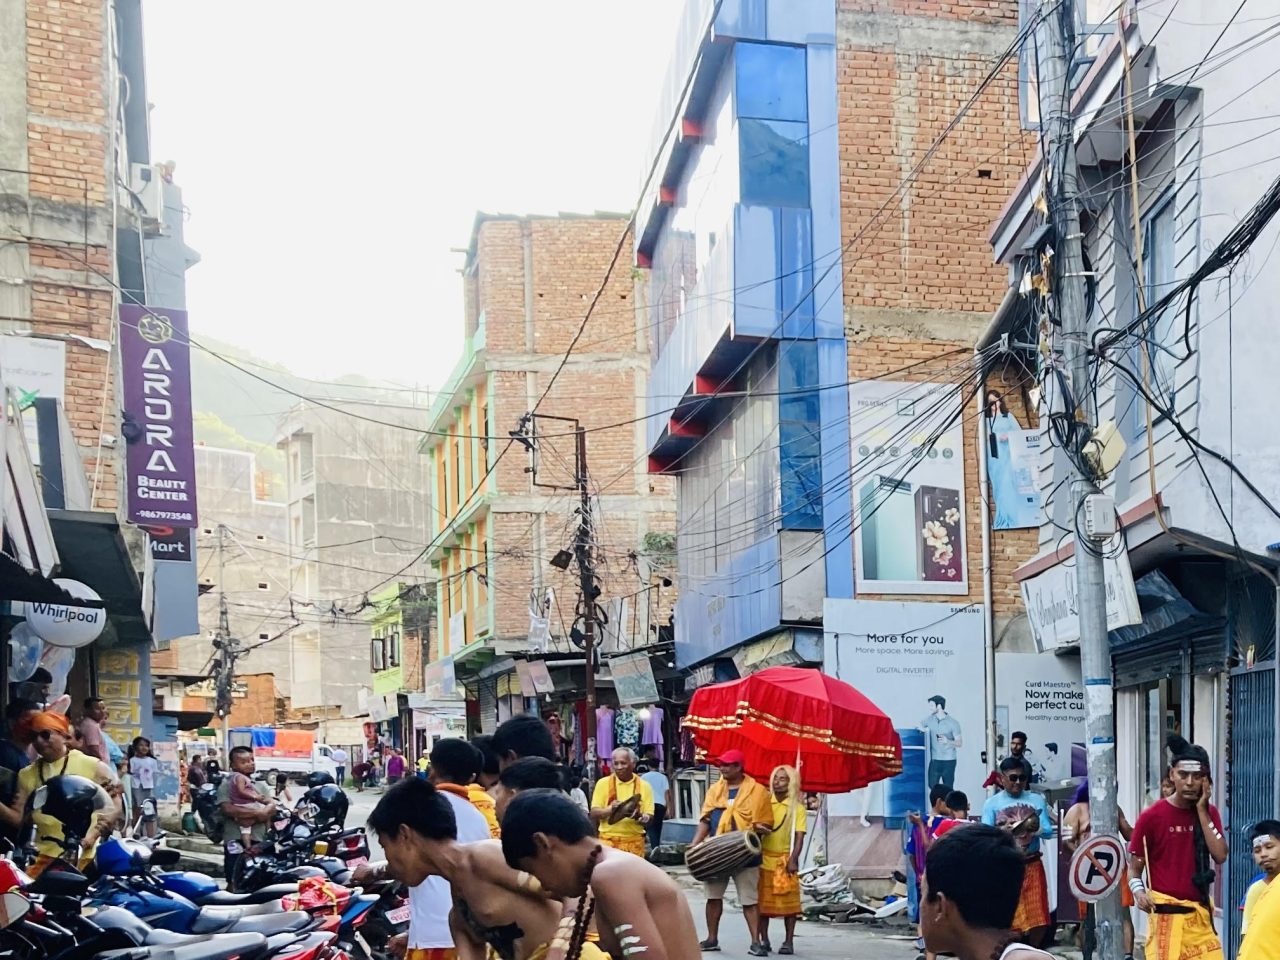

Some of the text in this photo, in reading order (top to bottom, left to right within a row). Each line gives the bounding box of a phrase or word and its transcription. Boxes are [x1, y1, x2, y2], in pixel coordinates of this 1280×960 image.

[137, 475, 187, 490] BEAUTY
[137, 487, 188, 501] CENTER
[32, 602, 98, 624] Whirlpool
[867, 633, 944, 647] More for you
[855, 646, 875, 654] More
[876, 666, 935, 675] DIGITAL INVERTER
[1025, 680, 1042, 688] Curd
[1025, 689, 1084, 700] Now make
[1025, 699, 1067, 712] perfect
